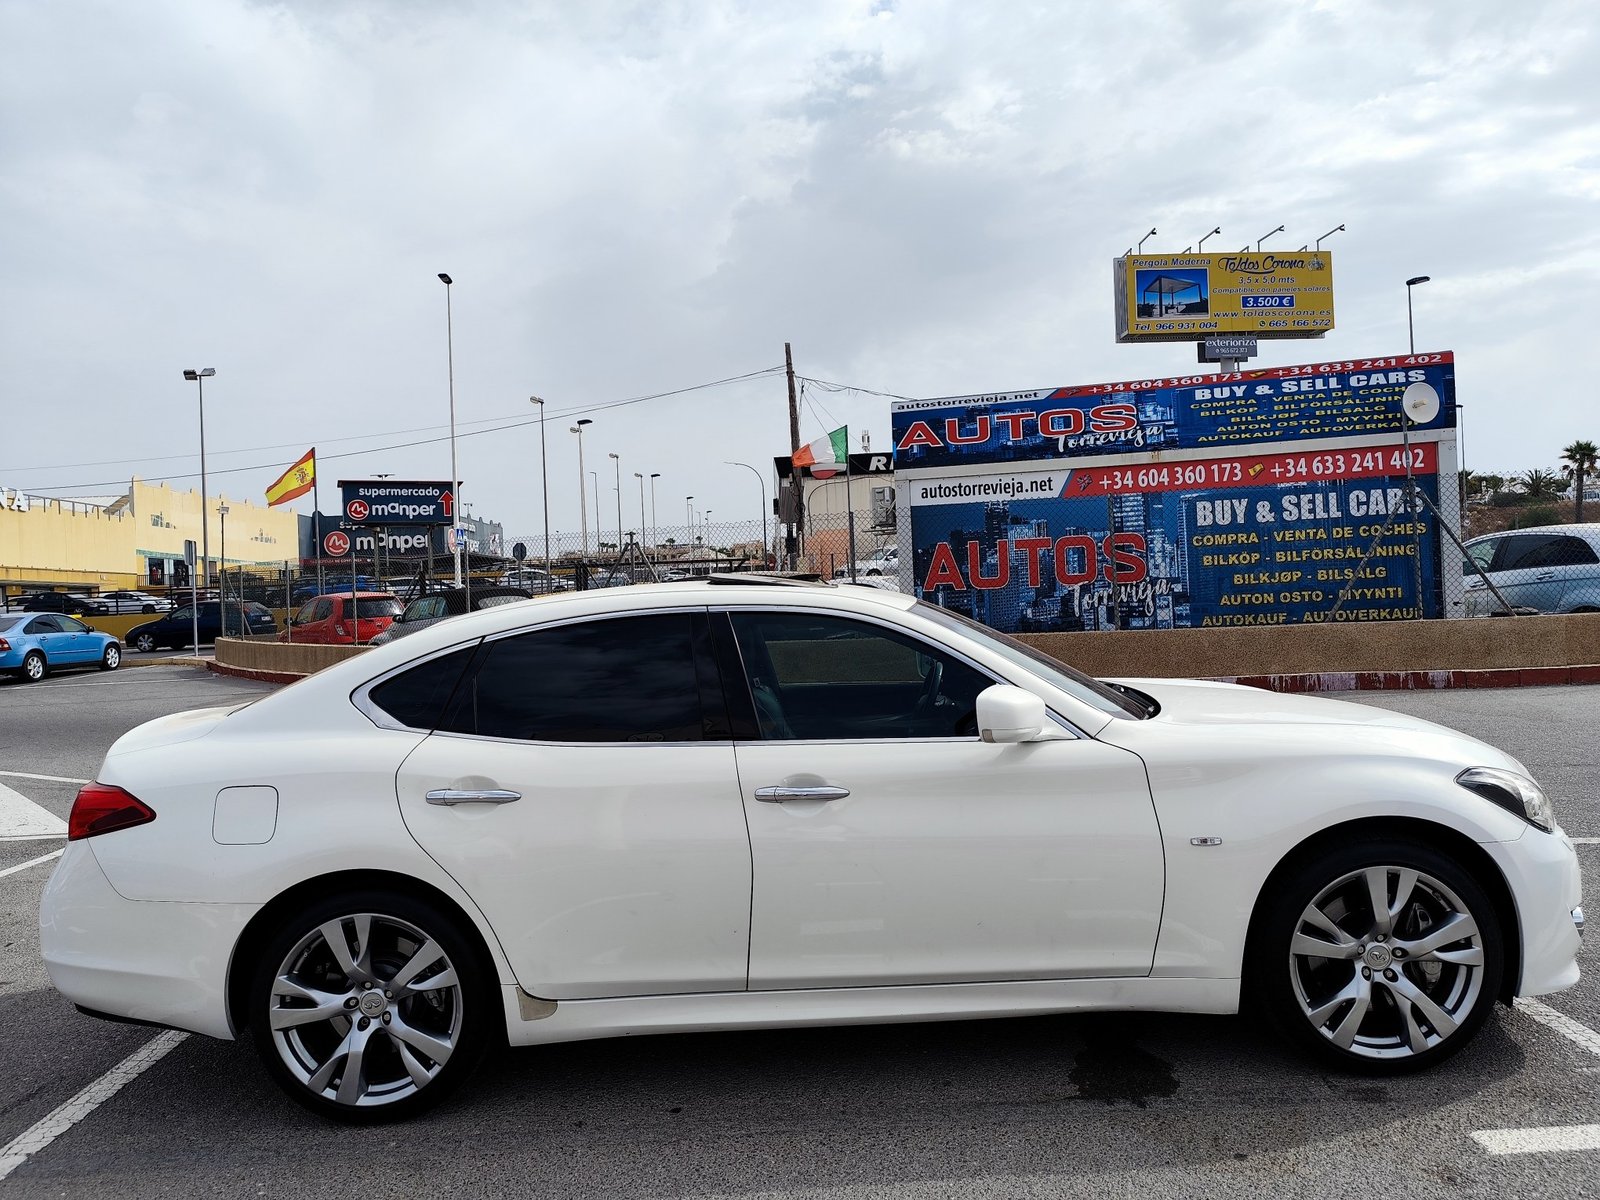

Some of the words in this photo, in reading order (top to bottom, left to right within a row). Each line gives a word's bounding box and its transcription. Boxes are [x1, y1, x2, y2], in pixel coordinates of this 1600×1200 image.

[1132, 258, 1168, 268] Pergola
[1171, 258, 1211, 266] Moderna
[1217, 256, 1260, 273] Toldos
[1262, 255, 1305, 271] Corona
[1212, 286, 1255, 294] Compatible
[1272, 286, 1301, 294] paneles
[1246, 296, 1279, 307] 3.500
[1282, 296, 1291, 306] €
[1156, 322, 1175, 330] 966
[1178, 322, 1195, 330] 931
[897, 392, 1039, 410] autostorrevieja.net
[1088, 384, 1125, 394] +34
[1130, 379, 1164, 390] 604
[1169, 376, 1203, 386] 360
[1210, 372, 1242, 382] 173
[1274, 366, 1313, 376] +34
[1319, 363, 1354, 372] 633
[1362, 358, 1396, 368] 241
[1404, 355, 1442, 364] 402
[1194, 385, 1248, 400] BUY
[1255, 385, 1274, 395] &
[1281, 377, 1341, 393] SELL
[1349, 370, 1426, 387] CARS
[1190, 399, 1257, 409] COMPRA
[1273, 393, 1326, 402] VENTA
[1231, 412, 1299, 422] BILKJØP
[1316, 405, 1385, 416] BILSALG
[897, 403, 1138, 450] AUTOS
[1217, 423, 1271, 432] AUTON
[1277, 419, 1320, 427] OSTO
[1336, 413, 1401, 422] MYYNTI
[1051, 426, 1161, 452] Torrevieja
[1198, 430, 1284, 442] AUTOKAUF
[868, 456, 894, 471] R
[921, 476, 1053, 499] autostorrevieja.net
[1099, 470, 1133, 490] +34
[1138, 468, 1169, 487] 604
[1174, 465, 1206, 485] 360
[1211, 462, 1242, 482] 173
[1270, 458, 1308, 478] +34
[1312, 455, 1345, 475] 633
[1351, 451, 1383, 472] 241
[1390, 448, 1424, 469] 402
[358, 486, 439, 498] supermercado
[372, 503, 436, 519] manper
[1196, 498, 1248, 526] BUY
[1256, 501, 1275, 523] &
[1281, 492, 1342, 520] SELL
[1349, 487, 1424, 516] CARS
[1192, 532, 1259, 546] COMPRA
[1274, 528, 1327, 542] VENTA
[1332, 527, 1353, 538] DE
[1359, 522, 1427, 536] COCHES
[923, 532, 1147, 591] AUTOS
[1203, 551, 1260, 566] BILKÖP
[1233, 571, 1302, 584] BILKJØP
[1317, 567, 1387, 580] BILSALG
[1070, 576, 1172, 617] Torrevieja
[1220, 593, 1274, 606] AUTON
[1280, 591, 1323, 603] OSTO
[1339, 587, 1402, 600] MYYNTI
[1202, 613, 1287, 626] AUTOKAUF
